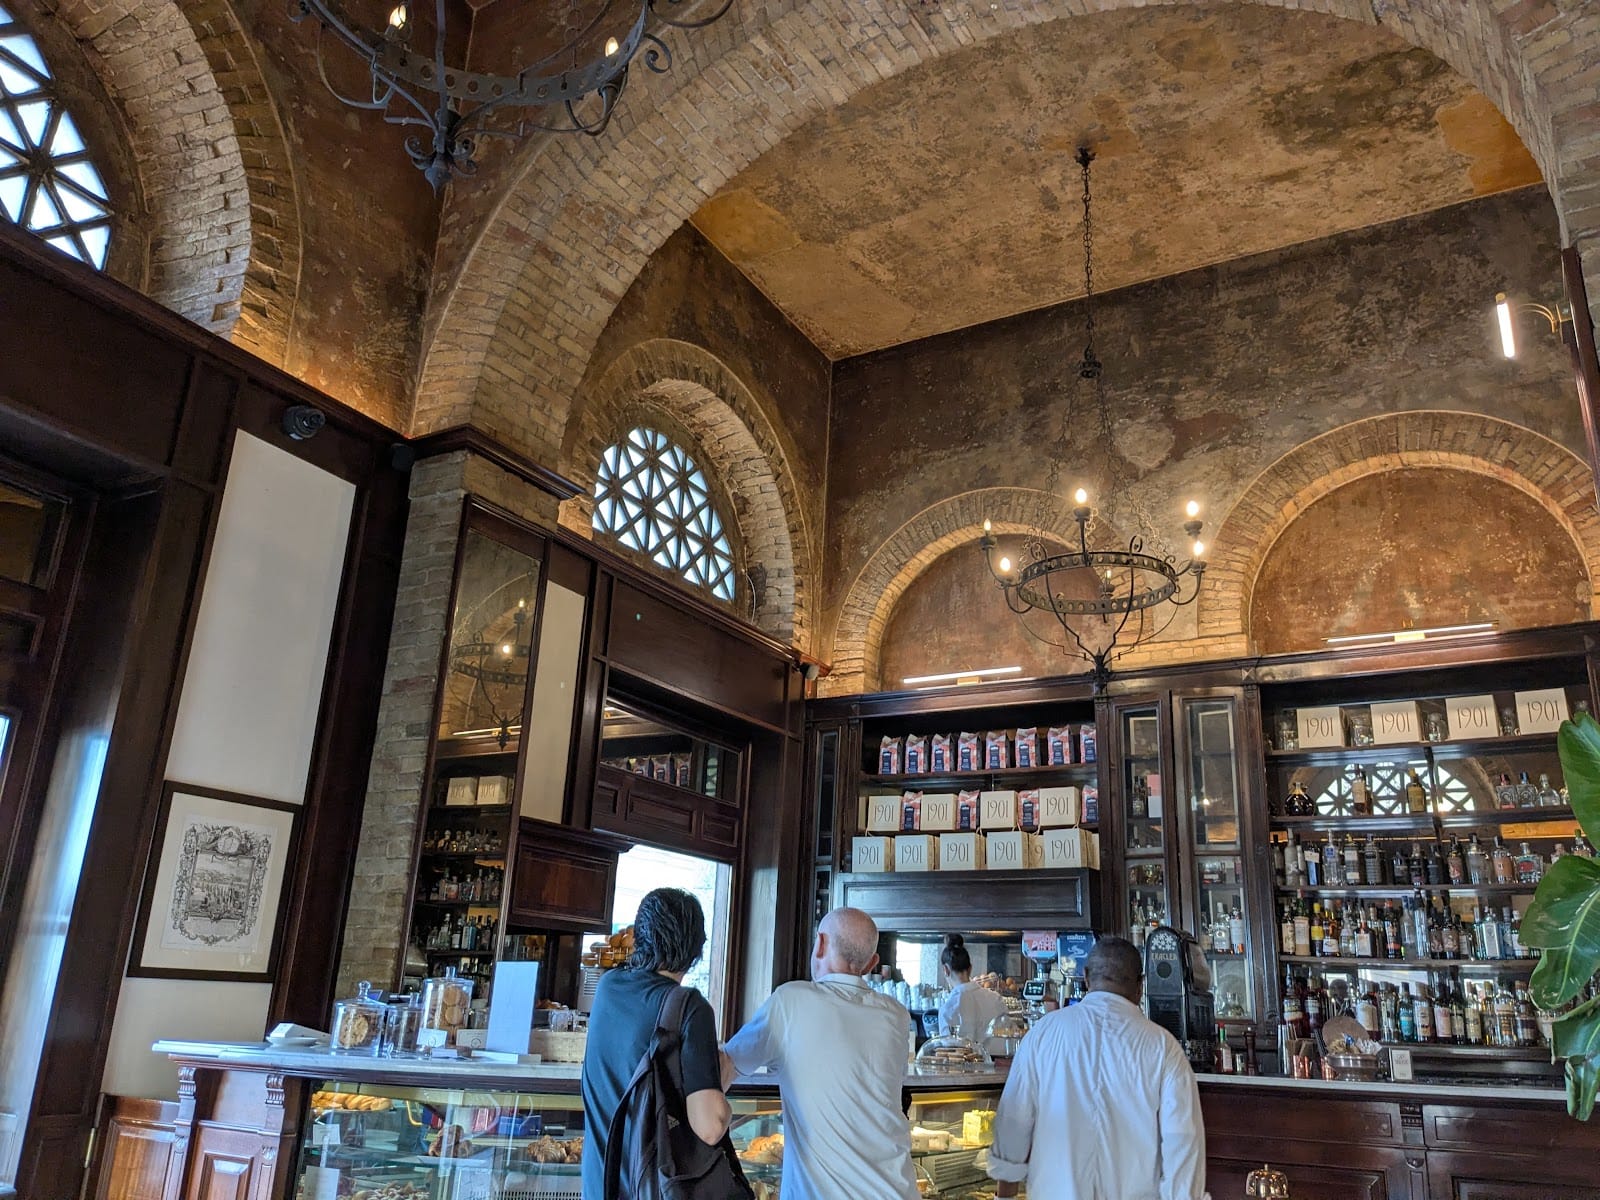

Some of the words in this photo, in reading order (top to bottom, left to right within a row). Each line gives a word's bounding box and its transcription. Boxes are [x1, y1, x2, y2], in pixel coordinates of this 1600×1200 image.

[1457, 706, 1489, 729] 1901
[1527, 700, 1560, 723] 1901
[1306, 717, 1333, 738] 1901
[1382, 712, 1410, 734] 1901
[874, 803, 894, 822] 1901
[927, 803, 948, 821] 1901
[987, 800, 1008, 819] 1901
[1046, 797, 1069, 816] 1901
[858, 847, 880, 864] 1901
[902, 845, 922, 863] 1901
[946, 842, 969, 862] 1901
[995, 841, 1017, 861] 1901
[1051, 839, 1075, 859] 1901
